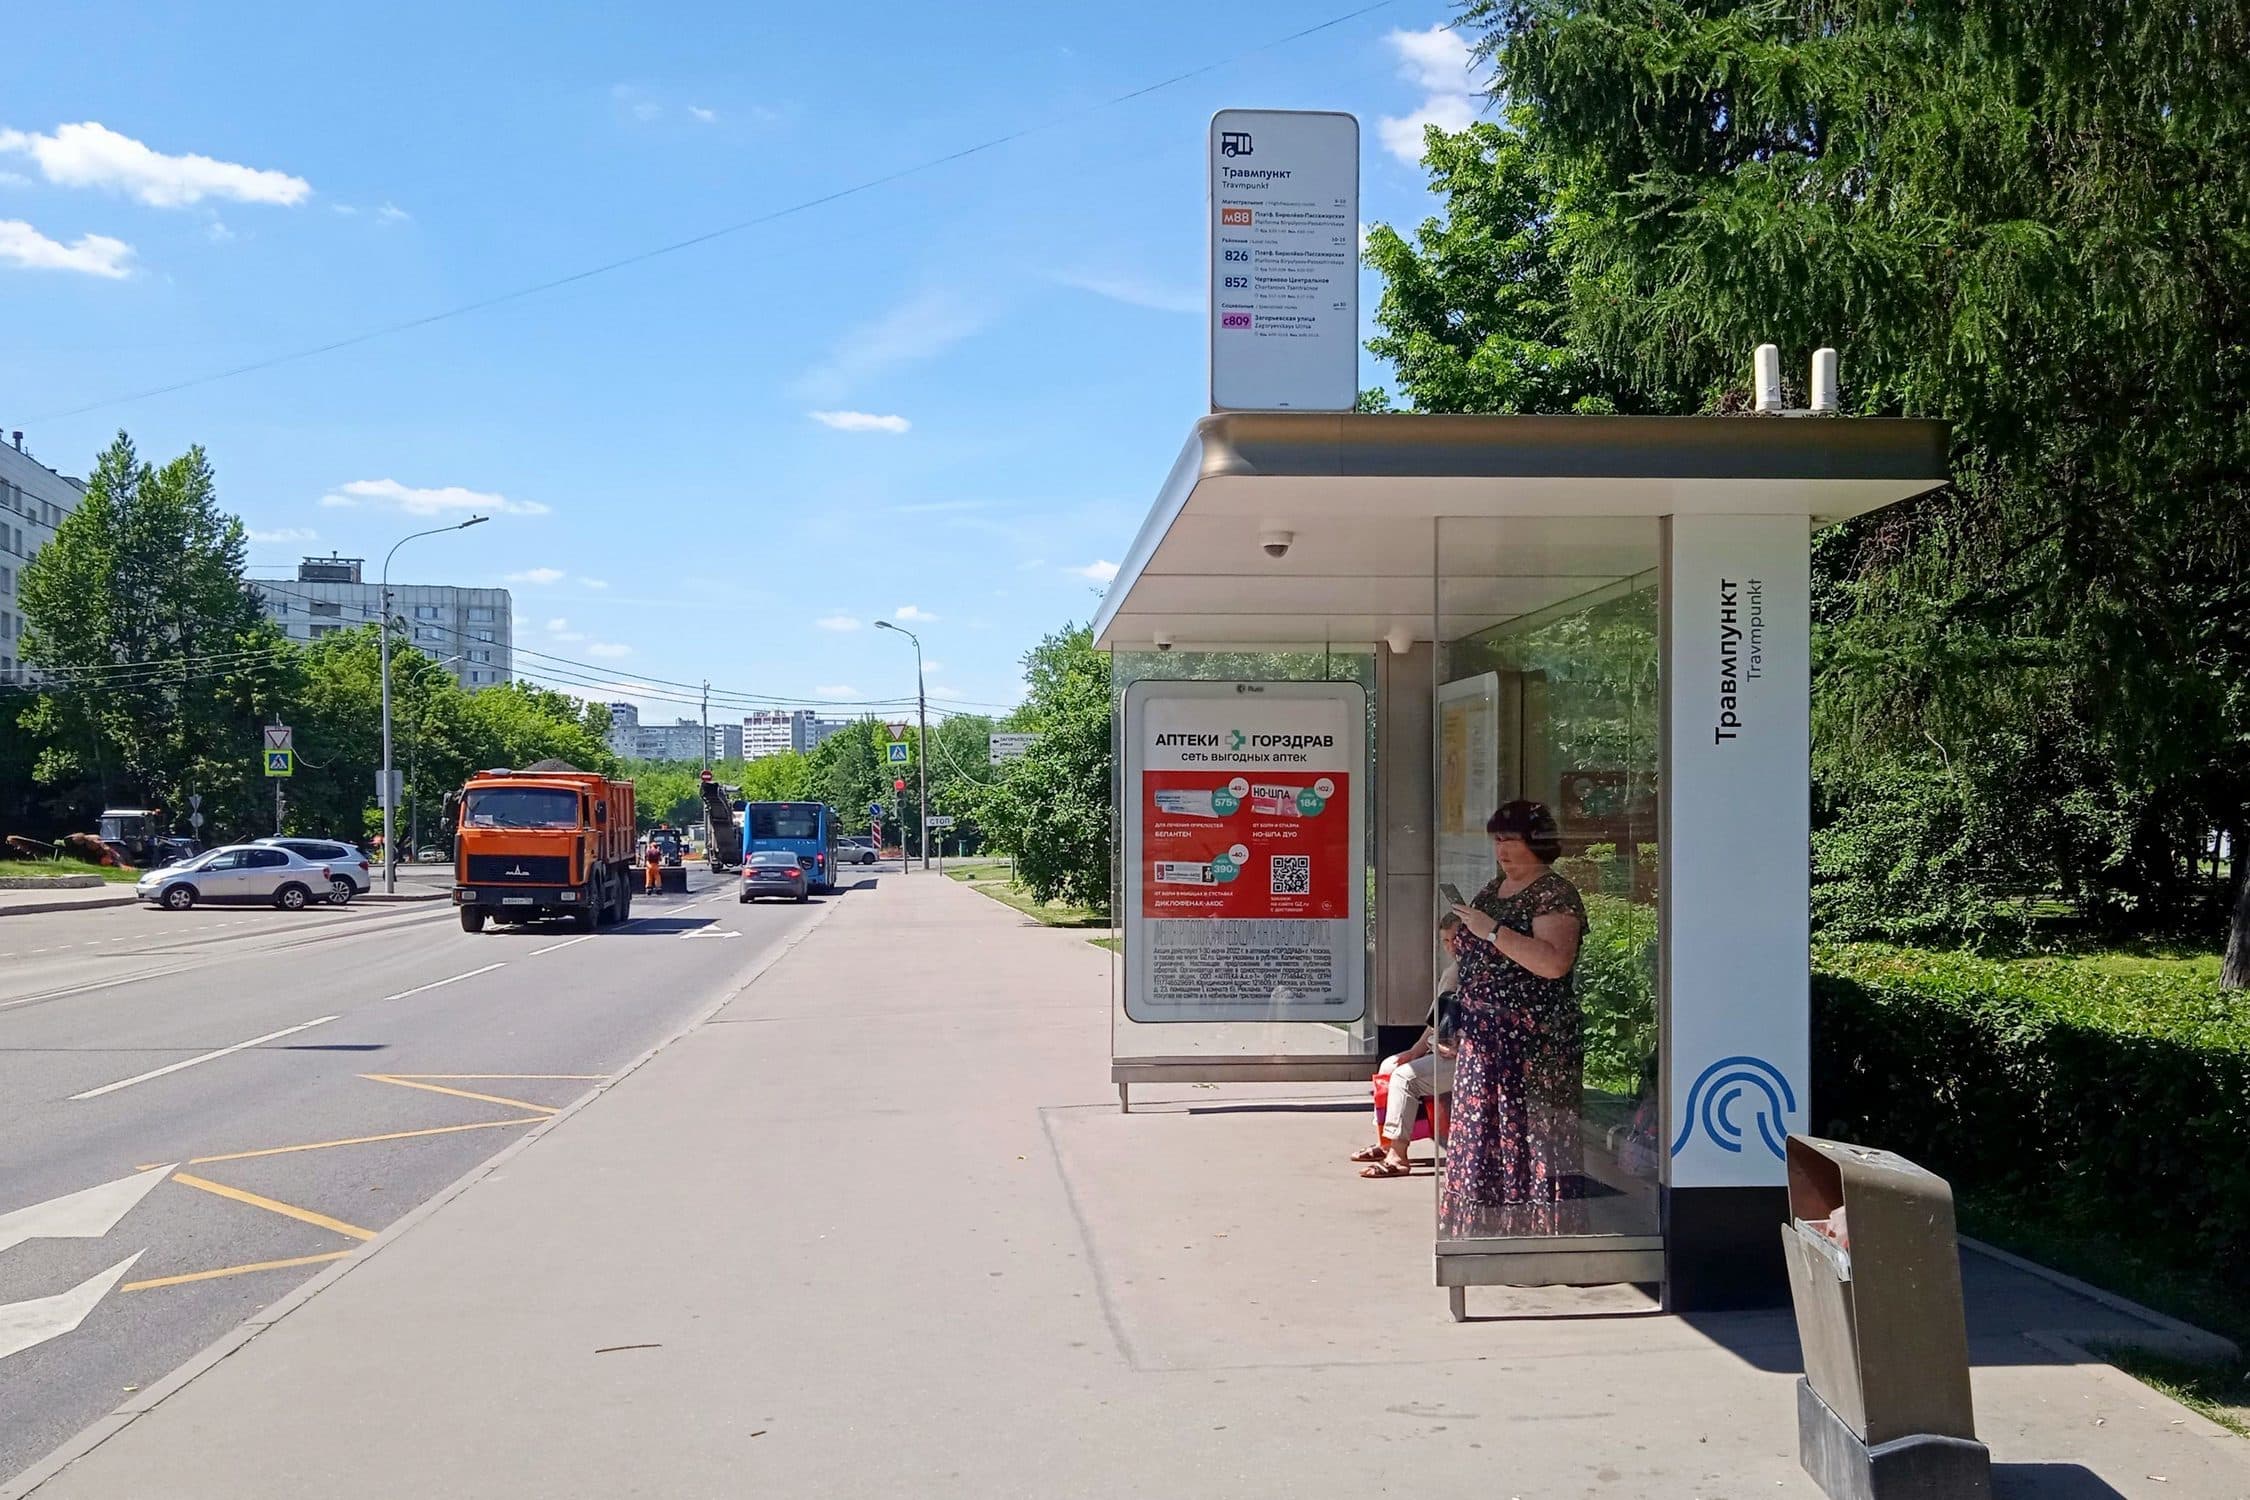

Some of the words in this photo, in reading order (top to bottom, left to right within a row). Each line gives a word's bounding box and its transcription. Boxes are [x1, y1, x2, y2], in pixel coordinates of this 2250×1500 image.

[1222, 167, 1291, 180] Травмпункт
[1222, 181, 1269, 190] Travmpunkt
[1224, 212, 1249, 223] м88
[1225, 251, 1248, 262] 826
[1225, 277, 1248, 288] 852
[1223, 316, 1250, 326] с809
[1746, 578, 1765, 683] Travmpunkt
[1715, 578, 1743, 745] Травмпункт
[1155, 734, 1219, 747] АПТЕКИ
[1252, 735, 1334, 749] ГОРЗДРАВ
[1181, 753, 1209, 762] сеть
[1211, 753, 1270, 763] выгодных
[1273, 753, 1307, 762] аптек
[1253, 787, 1290, 799] НО-ШПА
[1215, 798, 1233, 807] 575
[1300, 799, 1317, 807] 184
